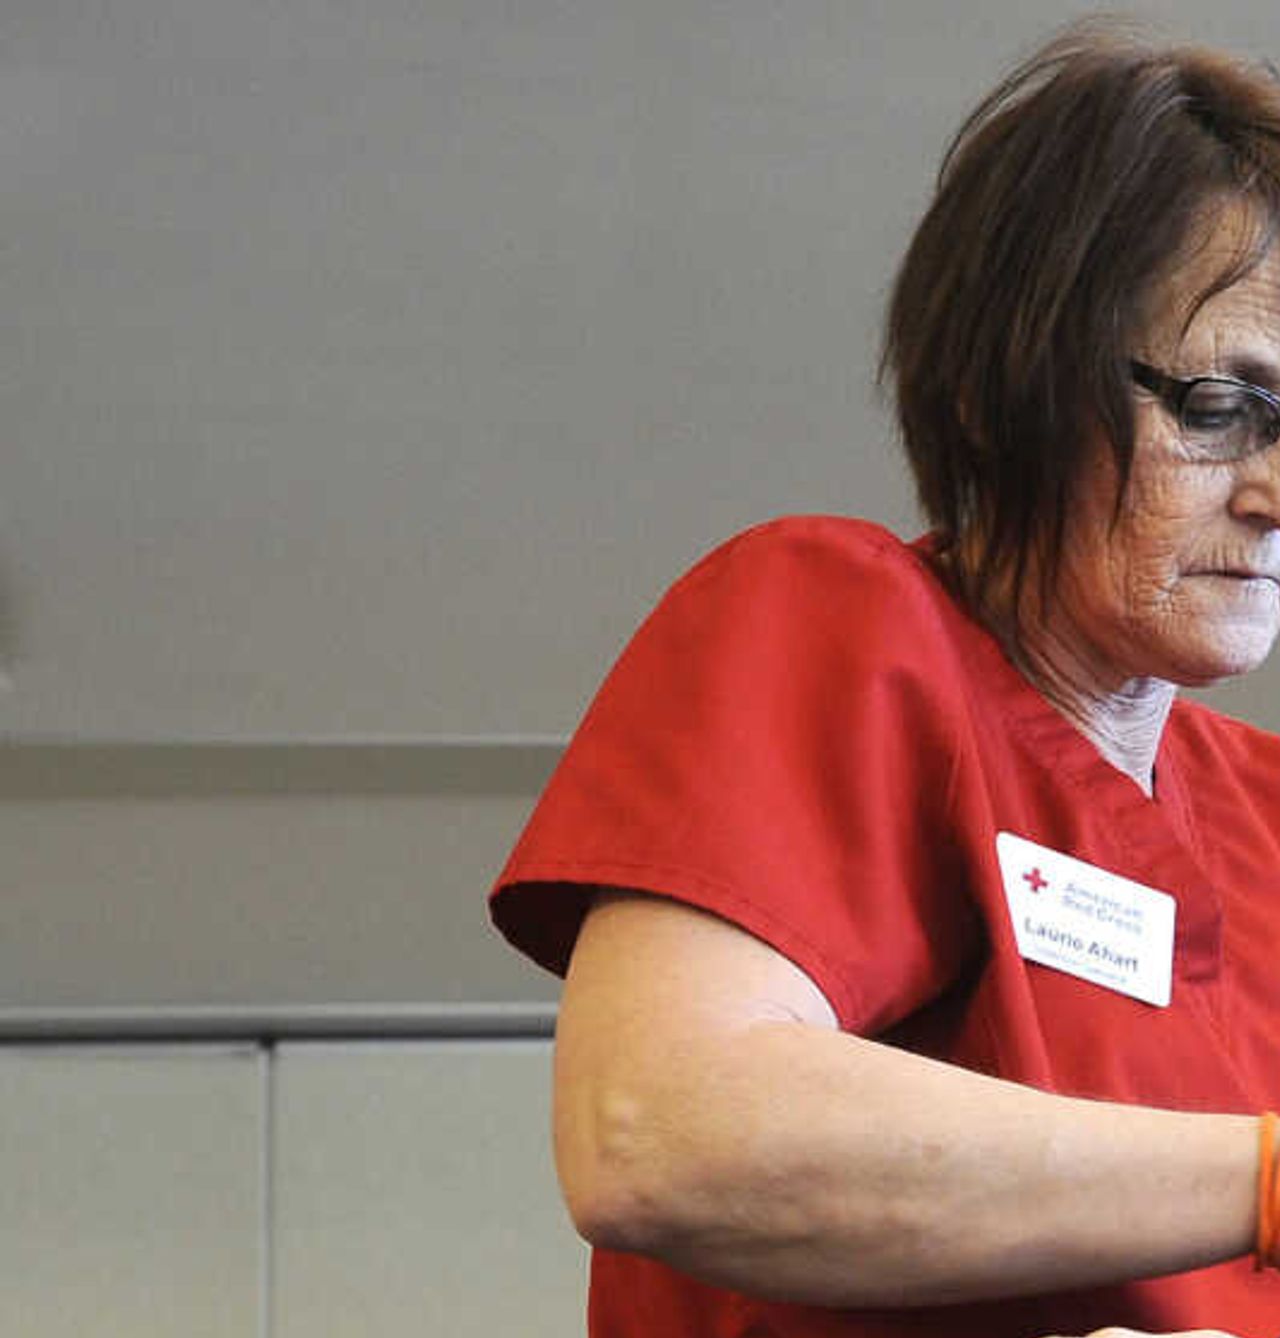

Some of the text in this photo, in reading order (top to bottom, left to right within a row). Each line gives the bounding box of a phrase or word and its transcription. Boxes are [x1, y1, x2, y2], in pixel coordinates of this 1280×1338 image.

[1063, 883, 1144, 917] American
[1097, 906, 1143, 936] Cross
[1024, 916, 1084, 951] Laurie
[1087, 941, 1138, 973] Ahart
